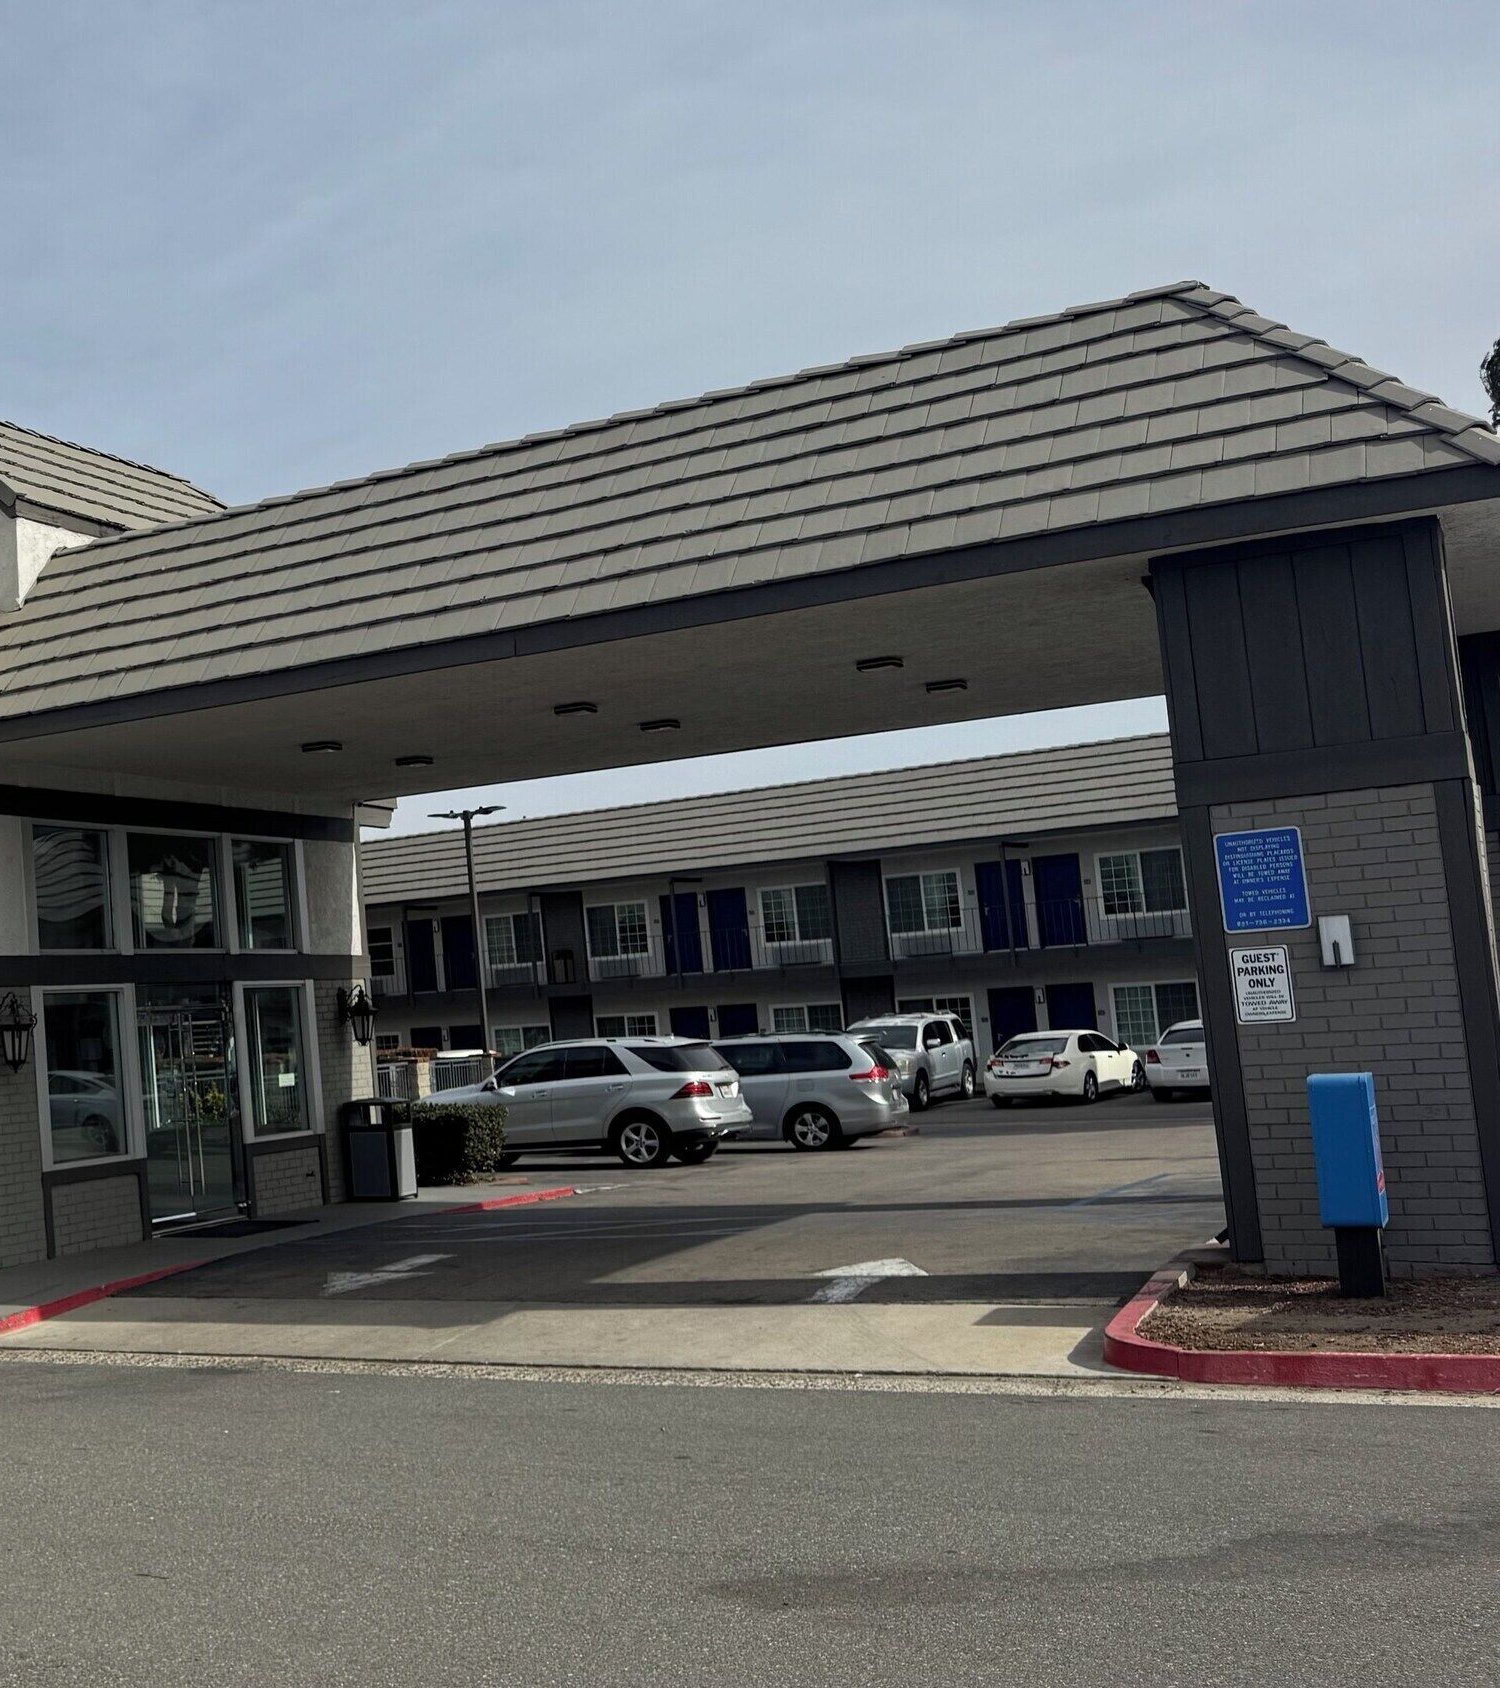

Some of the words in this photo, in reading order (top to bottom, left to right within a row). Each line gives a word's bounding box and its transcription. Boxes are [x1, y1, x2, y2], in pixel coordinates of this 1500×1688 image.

[1225, 838, 1263, 847] UNAUTHORIZED
[1225, 852, 1264, 860] DISTINGUISHING
[1260, 908, 1294, 916] TELEPHONING
[1242, 953, 1276, 964] GUEST
[1237, 965, 1284, 976] PARKING
[1248, 977, 1275, 988] ONLY
